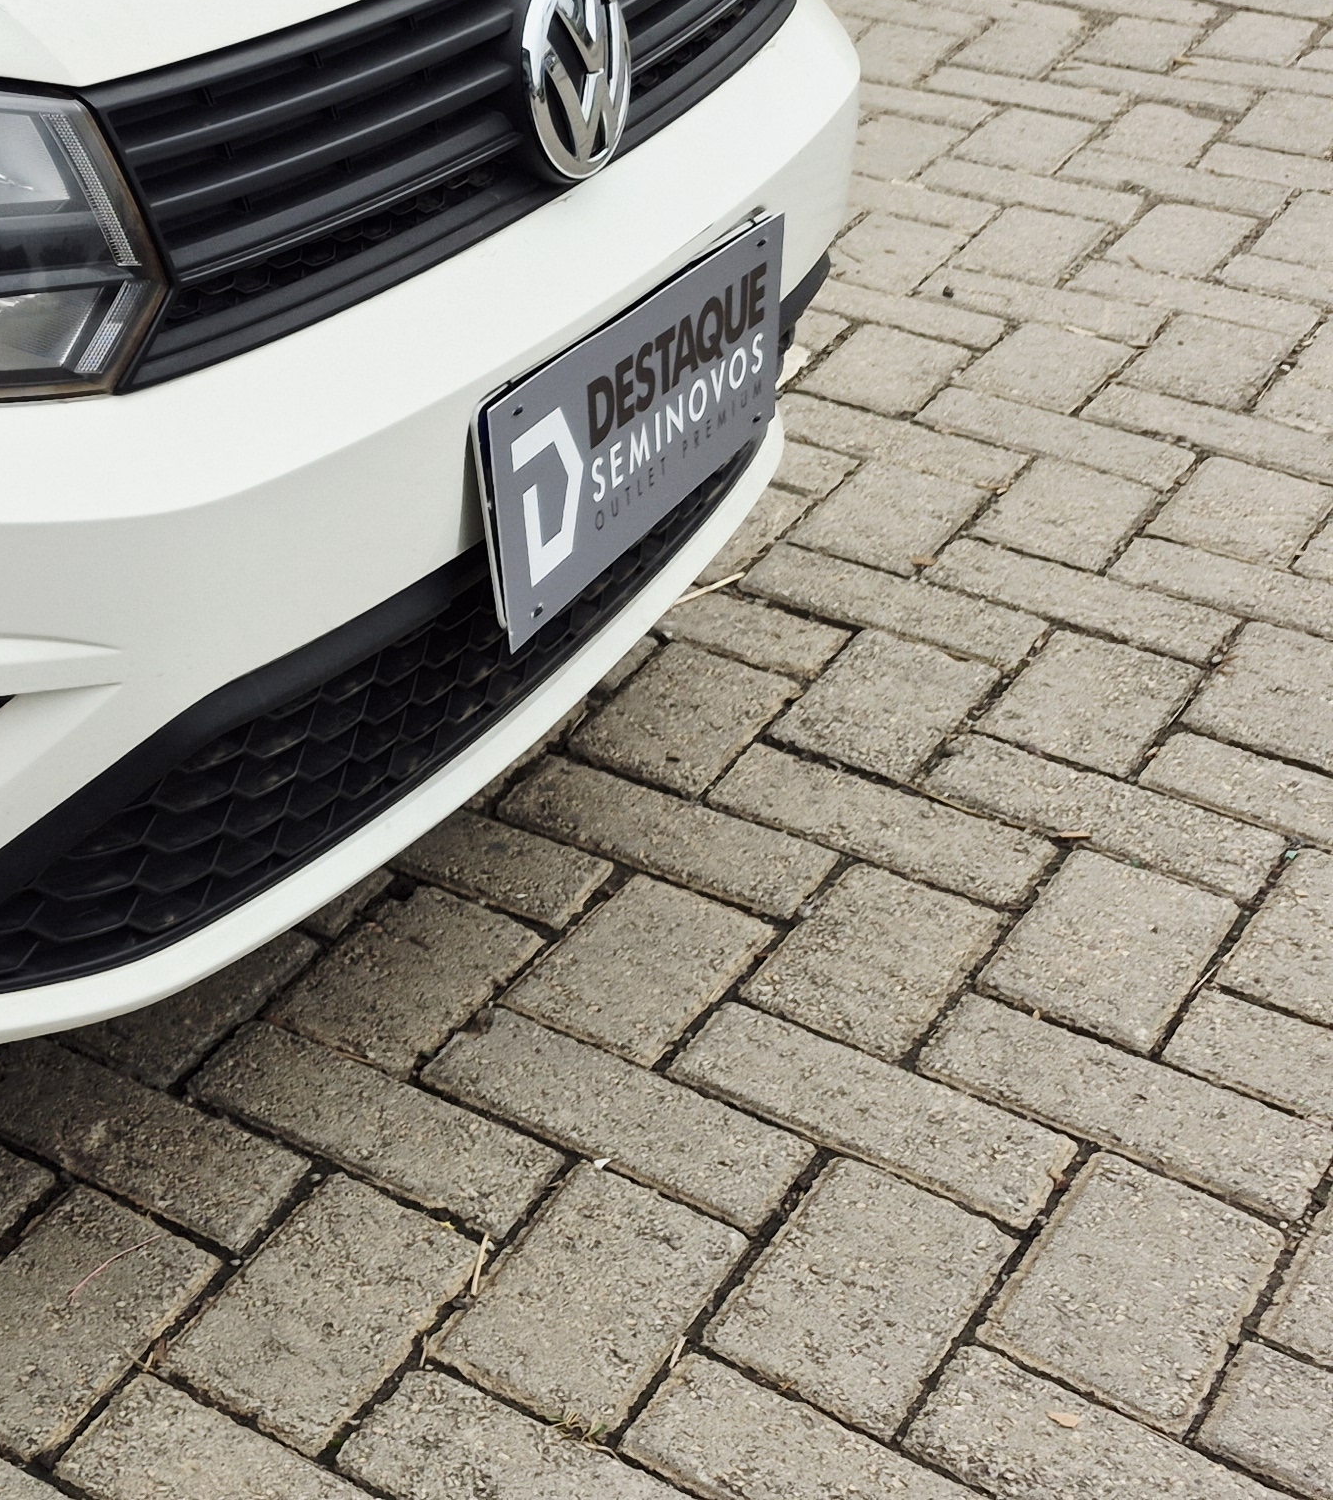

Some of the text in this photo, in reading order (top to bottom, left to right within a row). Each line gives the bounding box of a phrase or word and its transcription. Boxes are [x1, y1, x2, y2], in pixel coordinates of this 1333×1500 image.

[587, 261, 768, 450] DESTAQUE
[591, 332, 765, 504] SEMINOVOS
[594, 383, 764, 531] OUTLET PREMIUM
